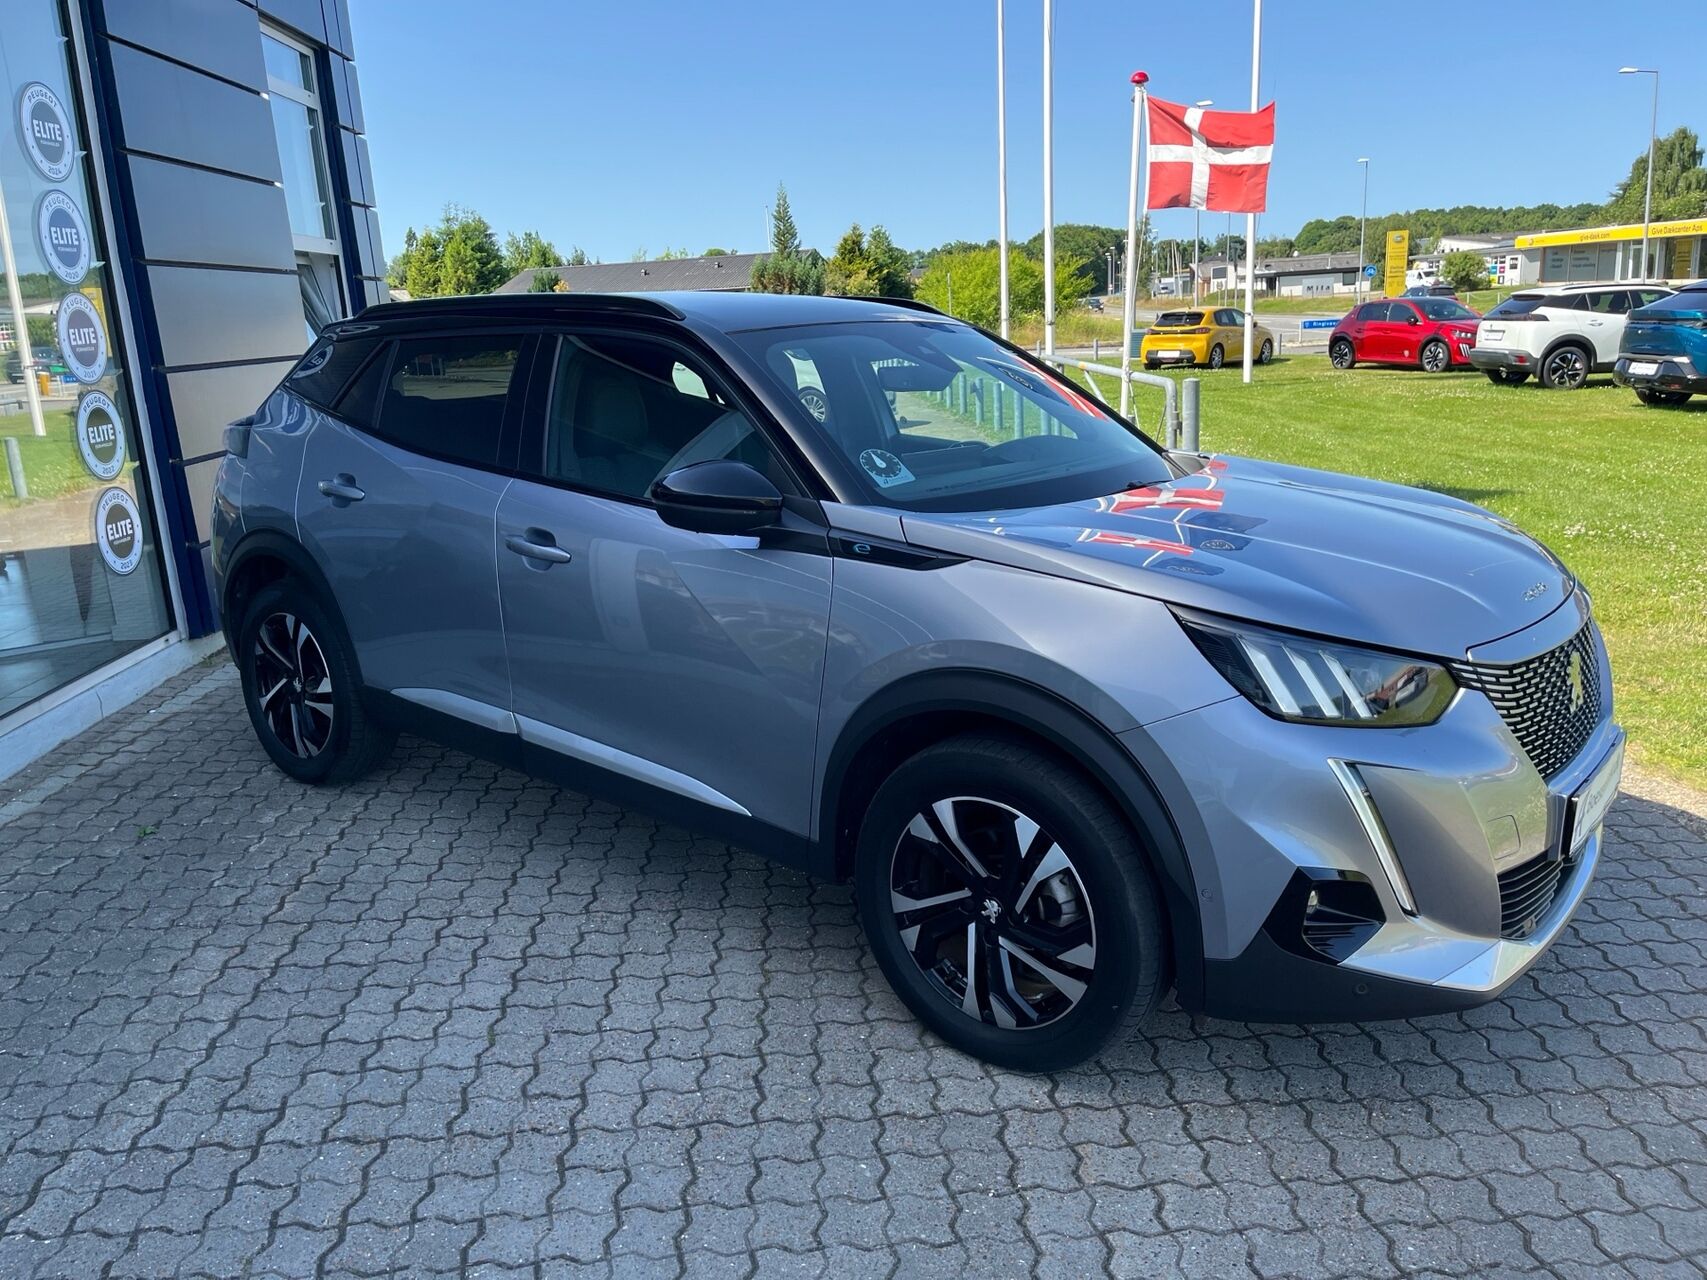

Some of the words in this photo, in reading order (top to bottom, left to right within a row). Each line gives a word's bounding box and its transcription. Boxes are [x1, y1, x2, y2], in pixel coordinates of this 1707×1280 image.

[27, 89, 58, 107] PEUGEOT
[33, 119, 62, 141] ELITE
[45, 196, 75, 214] PEUGEOT
[50, 226, 79, 246] ELITE
[64, 297, 92, 315] PEUGEOT
[69, 327, 97, 346] ELITE
[82, 396, 110, 413] PEUGEOT
[88, 423, 115, 444] ELITE
[101, 492, 129, 511] PEUGEOT
[107, 518, 133, 541] ELITE
